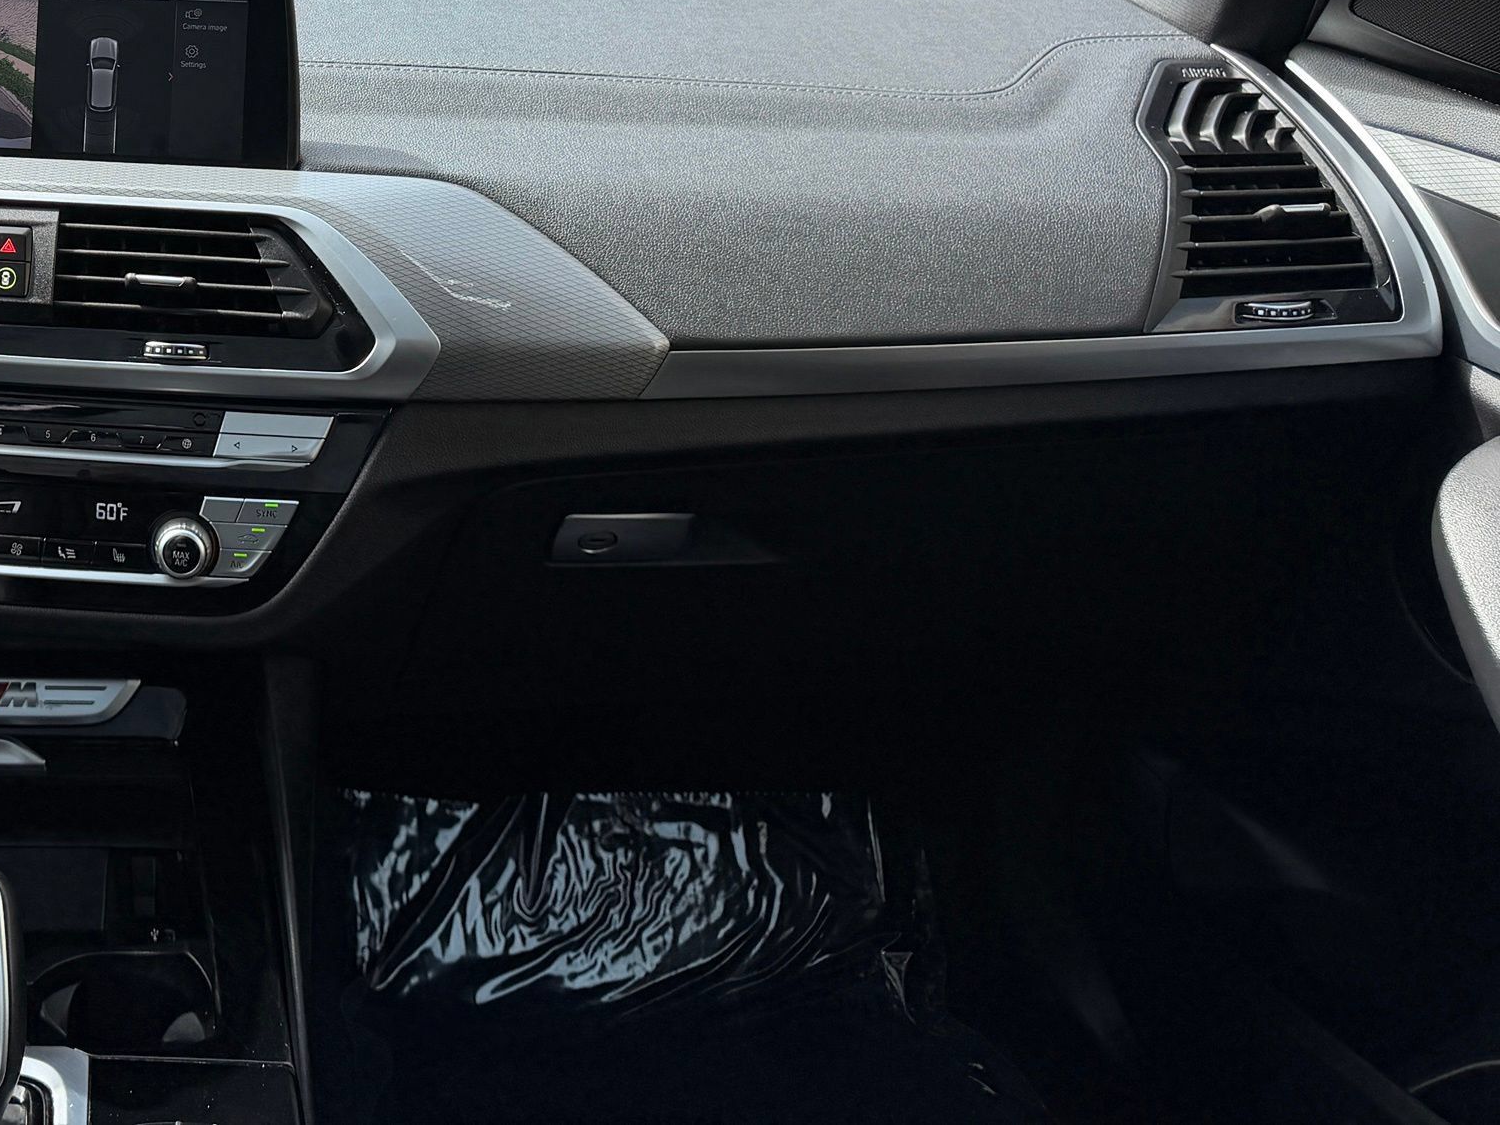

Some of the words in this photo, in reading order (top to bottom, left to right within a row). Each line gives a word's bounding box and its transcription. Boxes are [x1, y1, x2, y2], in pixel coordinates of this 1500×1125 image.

[182, 23, 206, 31] Camera
[207, 24, 228, 32] image
[180, 60, 207, 69] Settings
[1181, 66, 1226, 79] AIRBAG
[45, 429, 51, 439] 5
[90, 433, 96, 443] 6
[255, 509, 278, 519] SYNC
[172, 550, 190, 559] MAX
[174, 558, 188, 567] A/C
